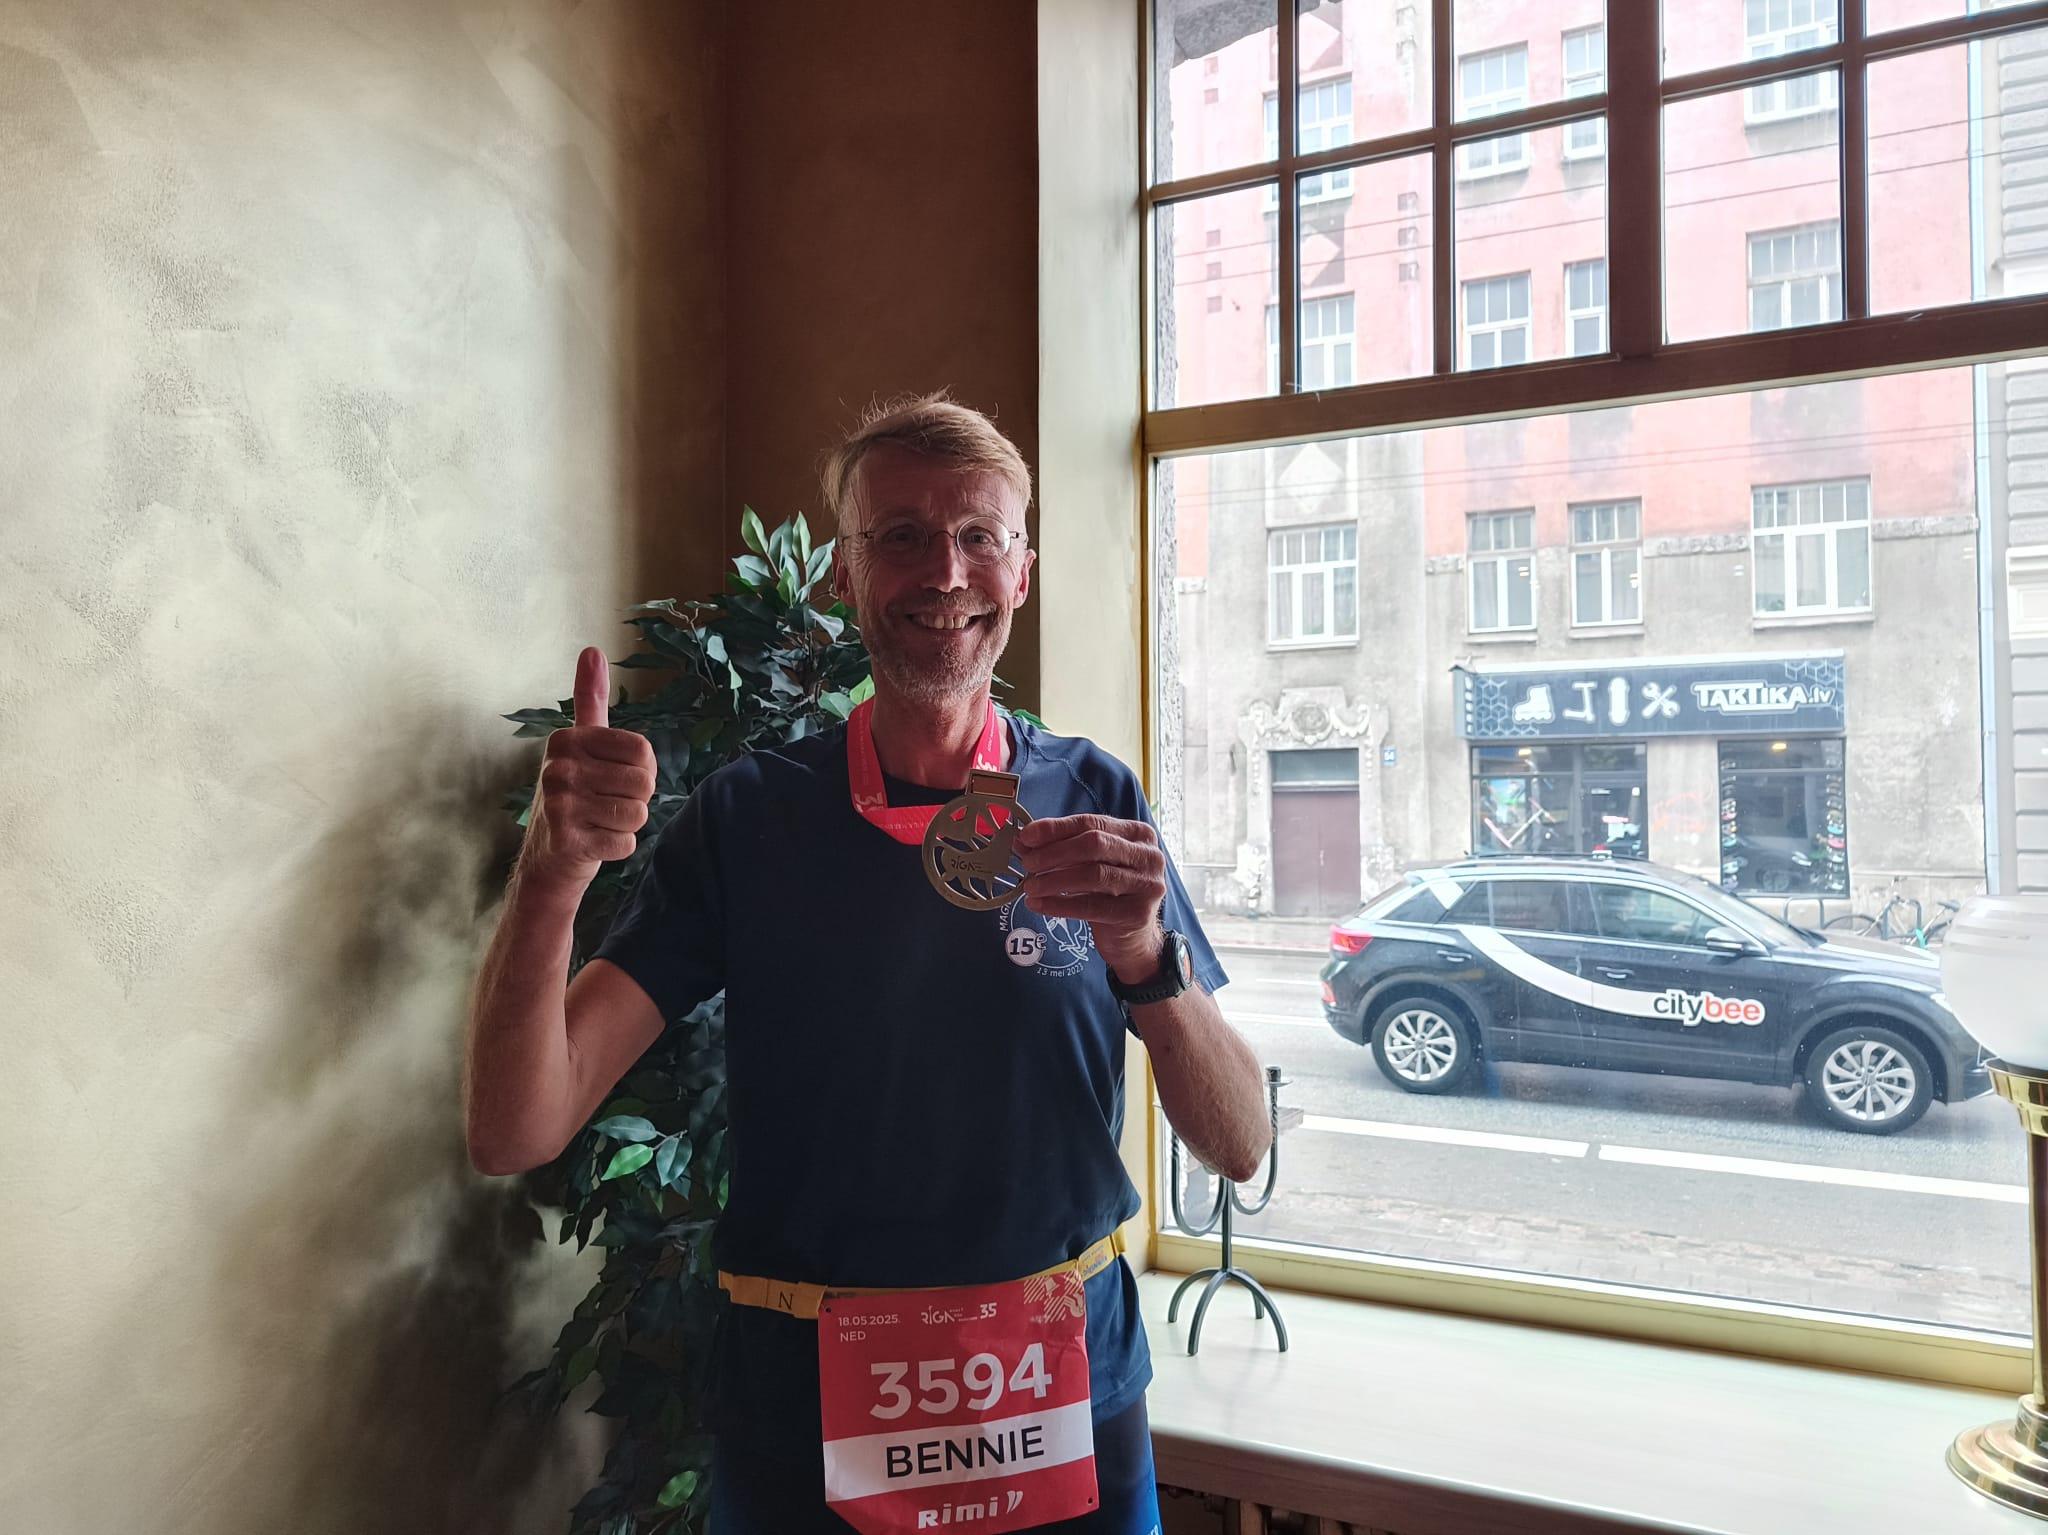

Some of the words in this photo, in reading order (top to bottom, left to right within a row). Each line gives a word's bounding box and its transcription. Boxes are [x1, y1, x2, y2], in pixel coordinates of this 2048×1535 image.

[1050, 969, 1065, 977] mei
[1653, 993, 1761, 1021] citybee
[980, 1302, 998, 1319] 35
[840, 1331, 866, 1342] NED
[869, 1342, 1053, 1420] 3594
[886, 1425, 1045, 1479] BENNIE
[918, 1497, 998, 1529] Rimi
